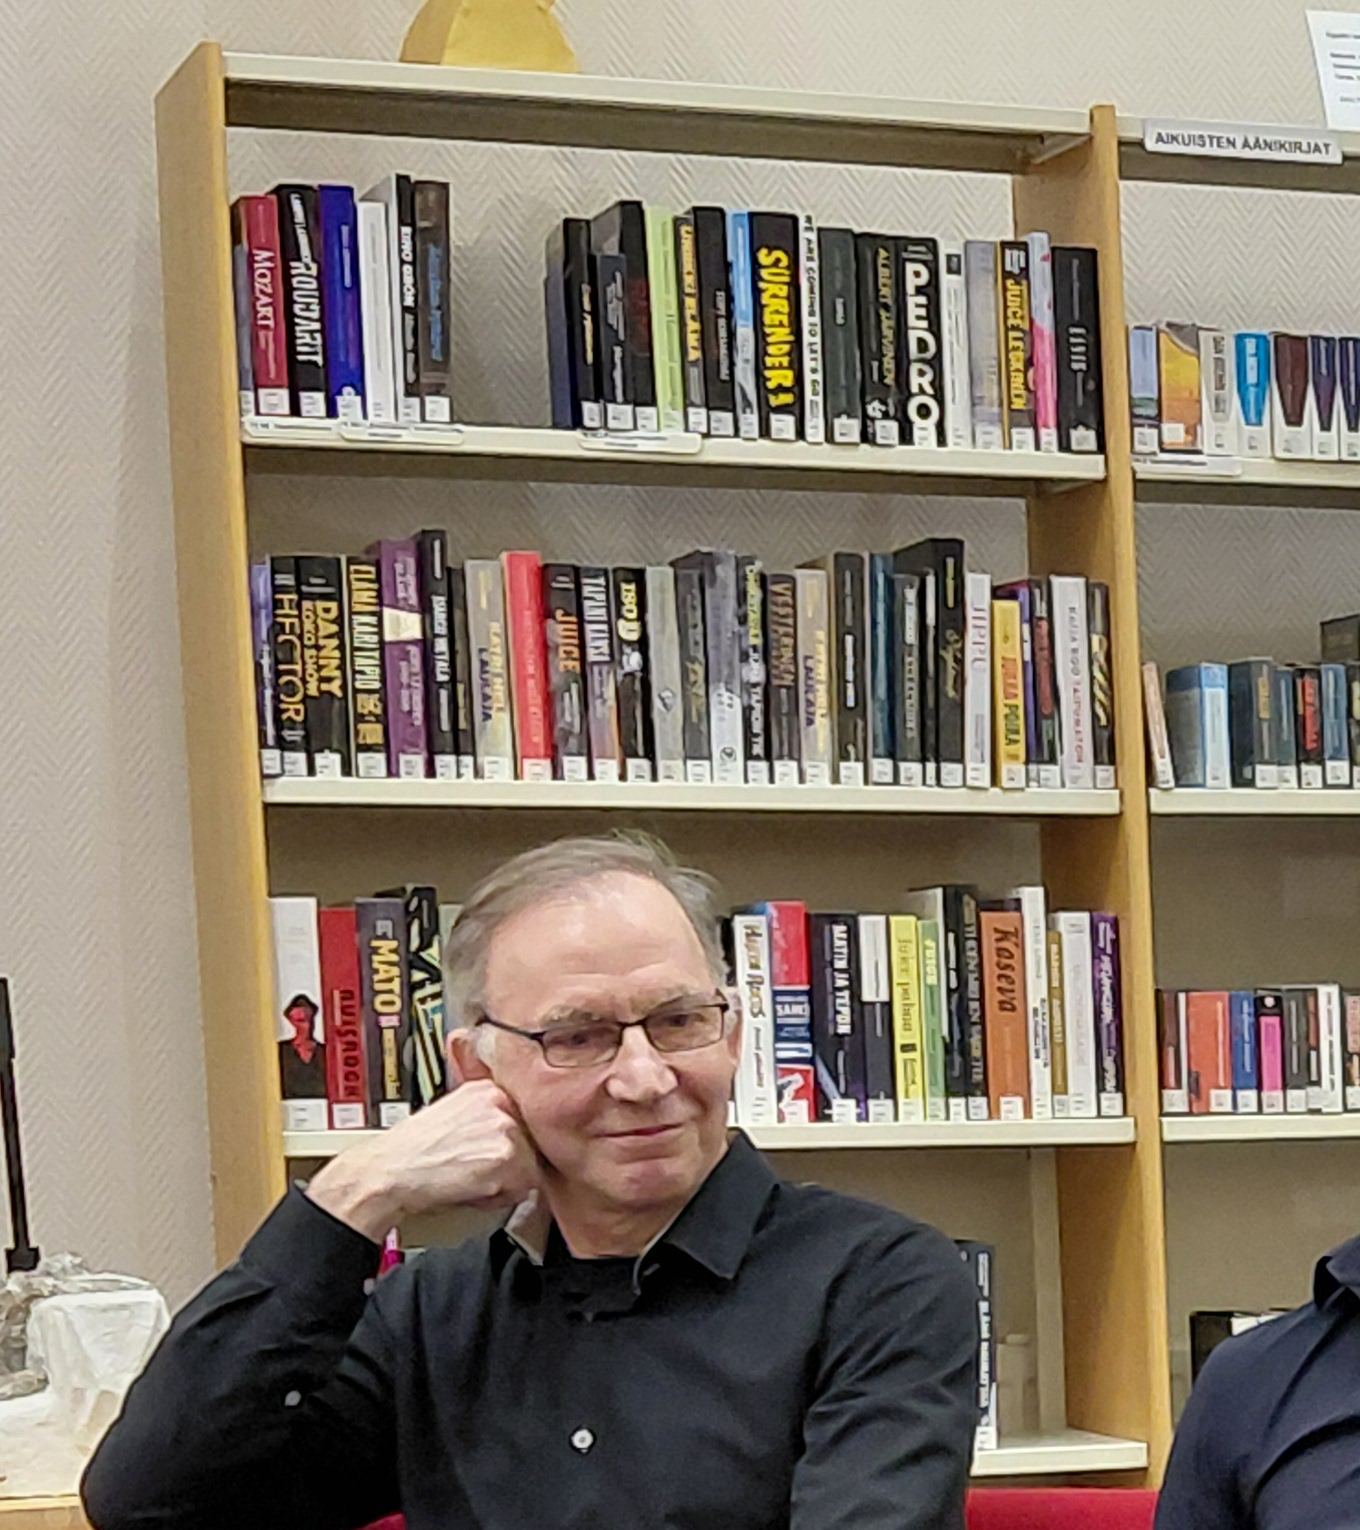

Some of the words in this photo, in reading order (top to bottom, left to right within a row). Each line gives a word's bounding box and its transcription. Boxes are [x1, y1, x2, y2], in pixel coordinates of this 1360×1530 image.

[1154, 131, 1237, 150] AIKUISTEN
[252, 249, 277, 329] MOZART
[877, 247, 894, 307] ALBERT
[1005, 278, 1025, 330] JUICE
[904, 261, 940, 427] PEDRO
[301, 599, 316, 646] KOKO
[581, 577, 609, 621] TAPANI
[314, 599, 344, 699] DANNY
[350, 614, 381, 649] KARI
[555, 608, 581, 674] JUICE
[584, 623, 611, 662] KANSA
[971, 604, 987, 674] JIPPU
[302, 647, 320, 697] SHOW
[353, 649, 383, 690] TAPIO
[1070, 647, 1081, 676] KOO
[1003, 703, 1021, 747] POIKA
[369, 939, 403, 1015] MATO
[992, 927, 1020, 1013] Kaseva
